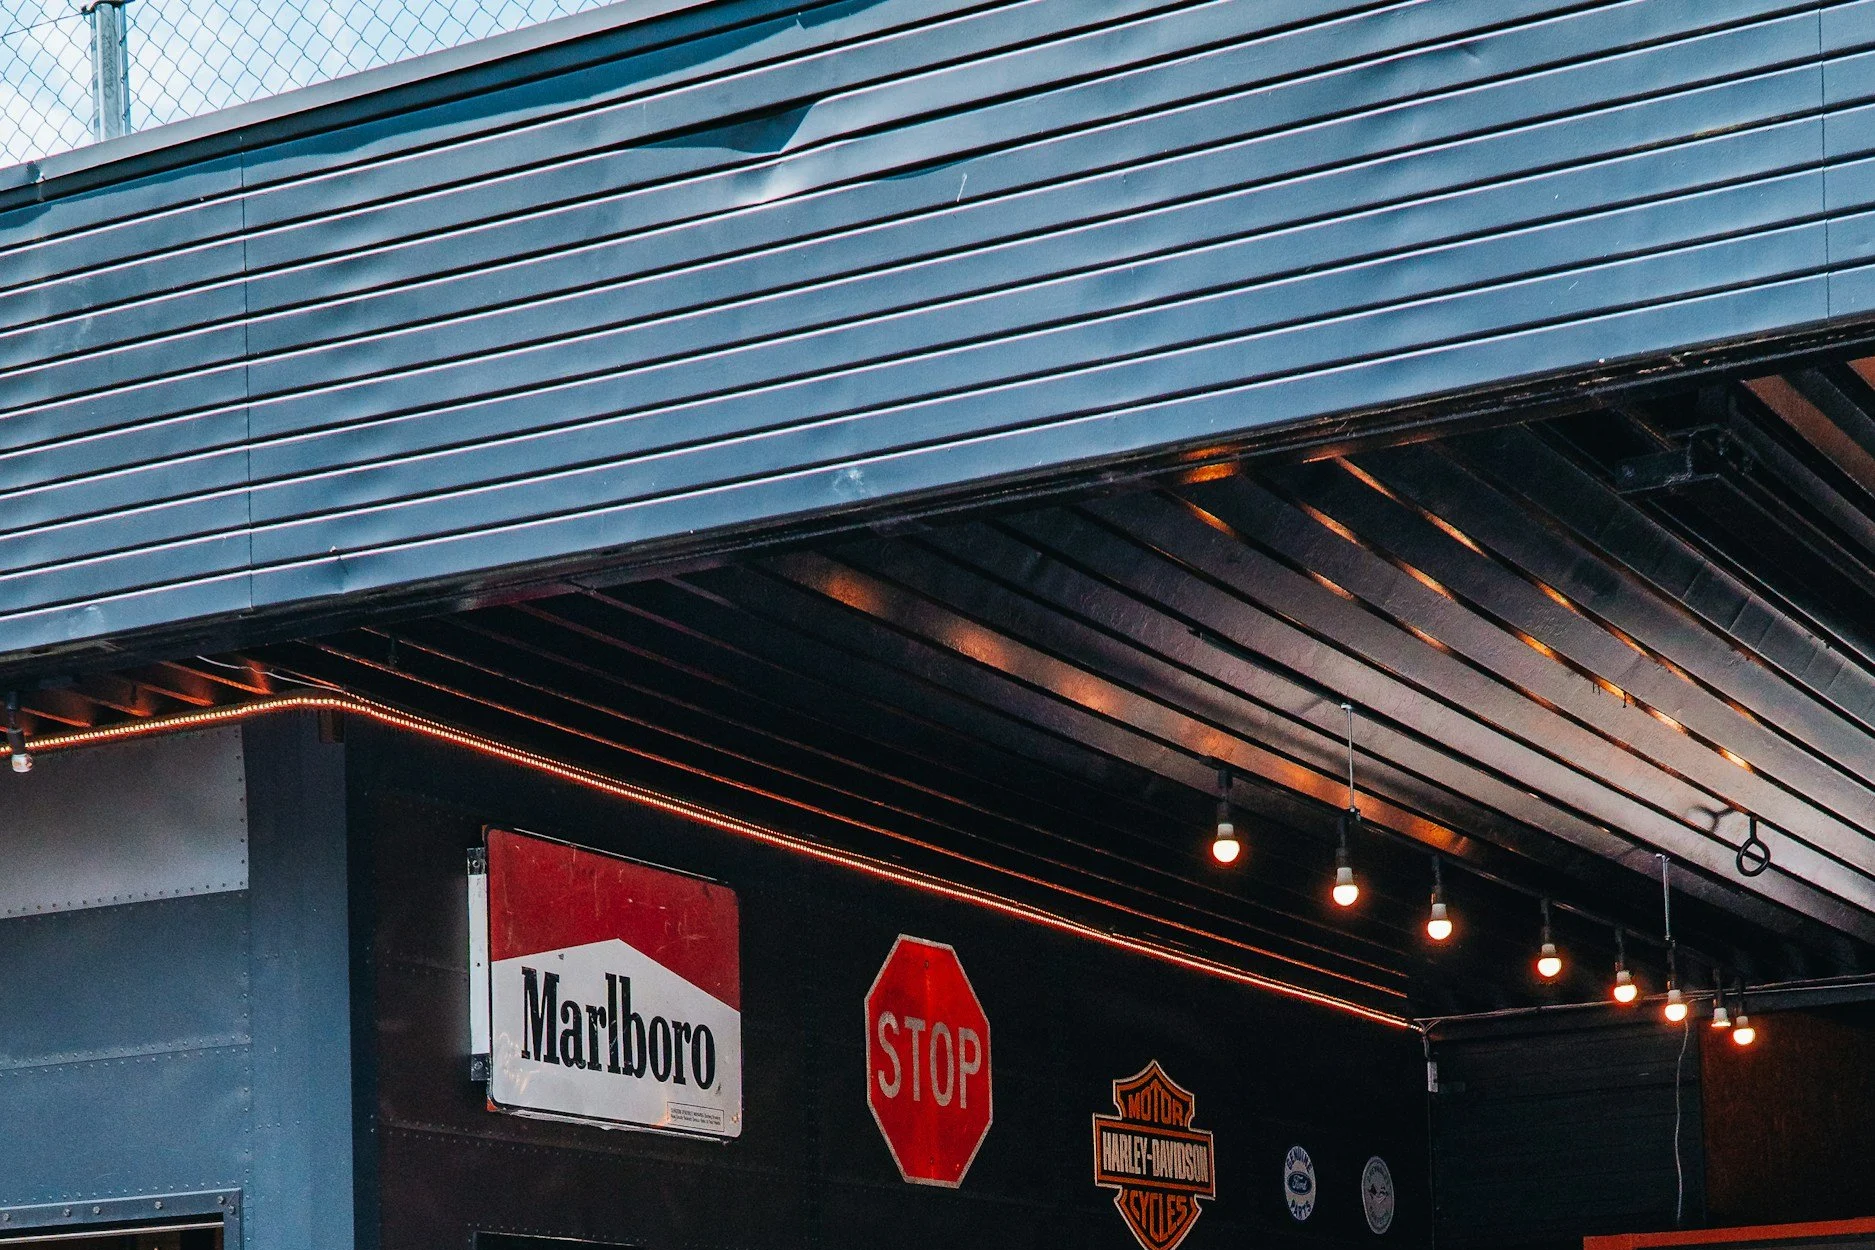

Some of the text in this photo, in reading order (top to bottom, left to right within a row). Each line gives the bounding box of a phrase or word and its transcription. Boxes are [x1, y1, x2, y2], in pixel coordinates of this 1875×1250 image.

[521, 966, 717, 1091] Marlboro
[876, 1010, 982, 1109] STOP
[1128, 1078, 1184, 1127] MOTOR
[1102, 1131, 1209, 1183] HARLEY-DAVIDSON
[1286, 1148, 1313, 1173] GENUINE
[1129, 1189, 1188, 1243] CYCLES
